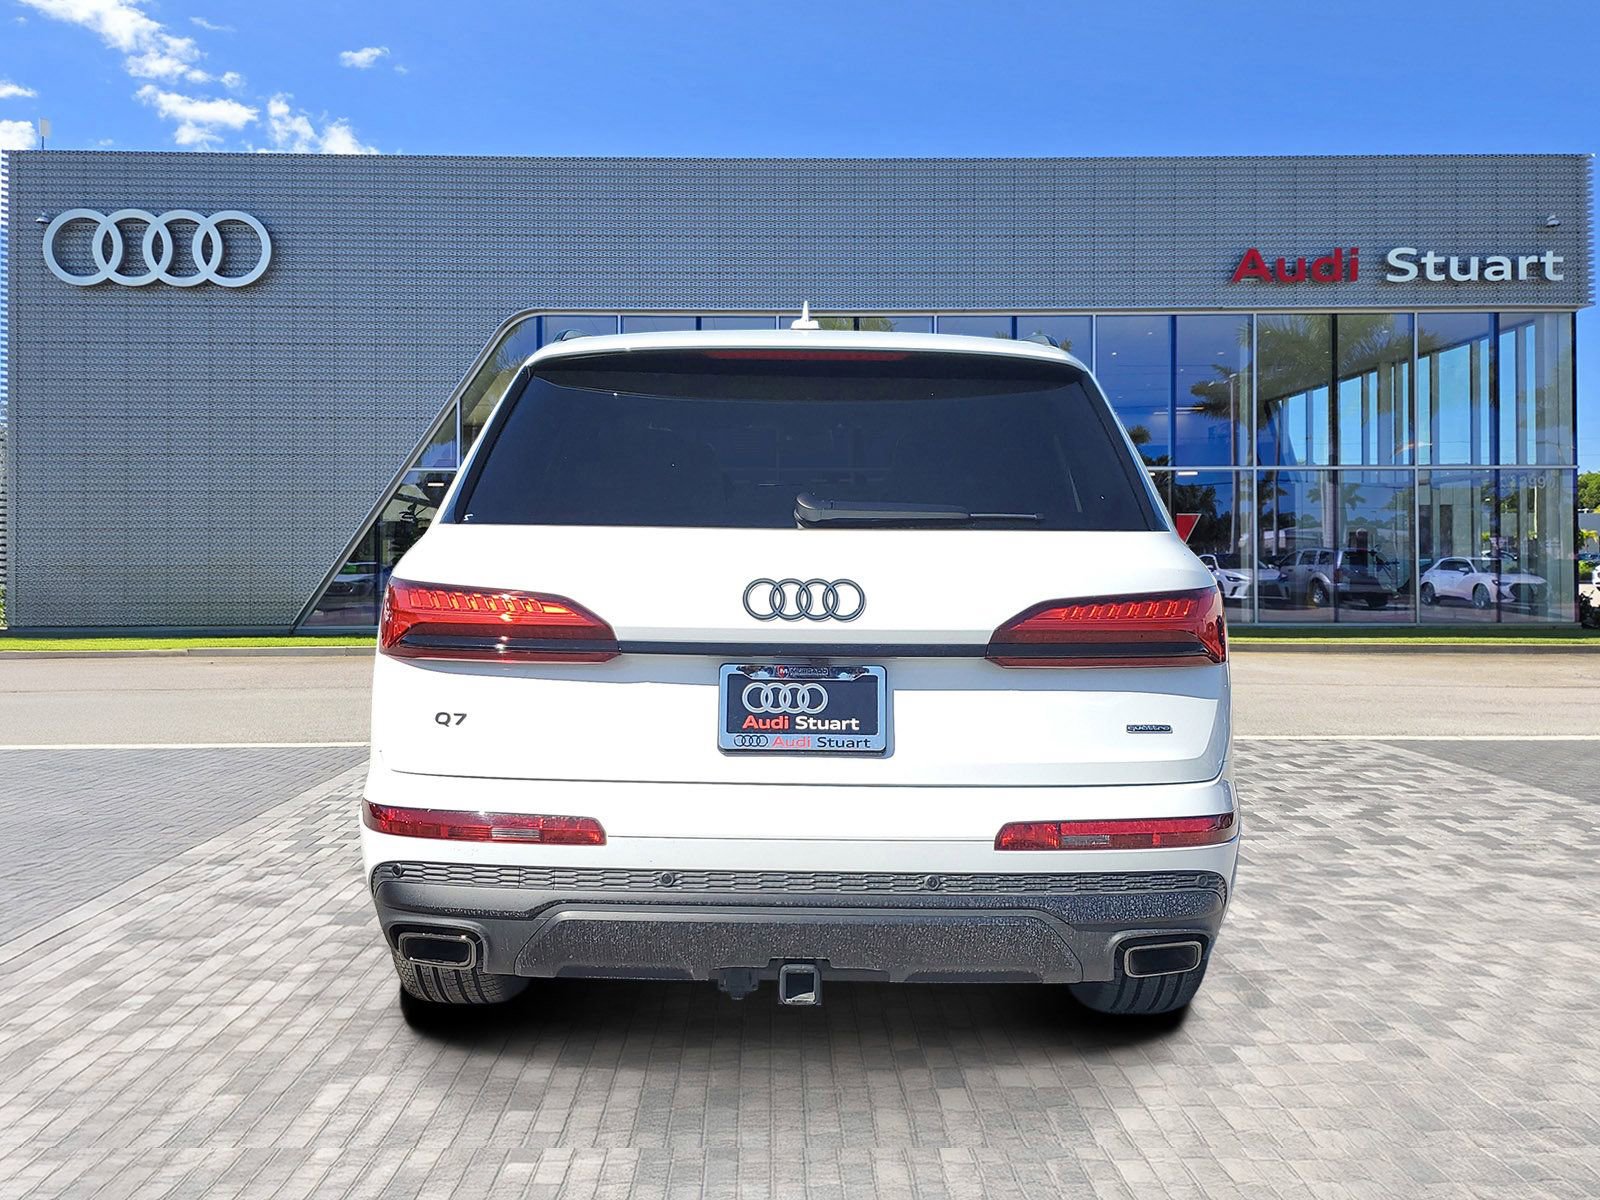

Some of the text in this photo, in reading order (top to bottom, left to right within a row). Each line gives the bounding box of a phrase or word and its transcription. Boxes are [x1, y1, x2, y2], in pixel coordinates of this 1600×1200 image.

[1231, 247, 1564, 284] Audi Stuart
[434, 711, 468, 728] Q7
[742, 715, 860, 731] Audi Stuart
[771, 735, 871, 749] Audi Stuart
